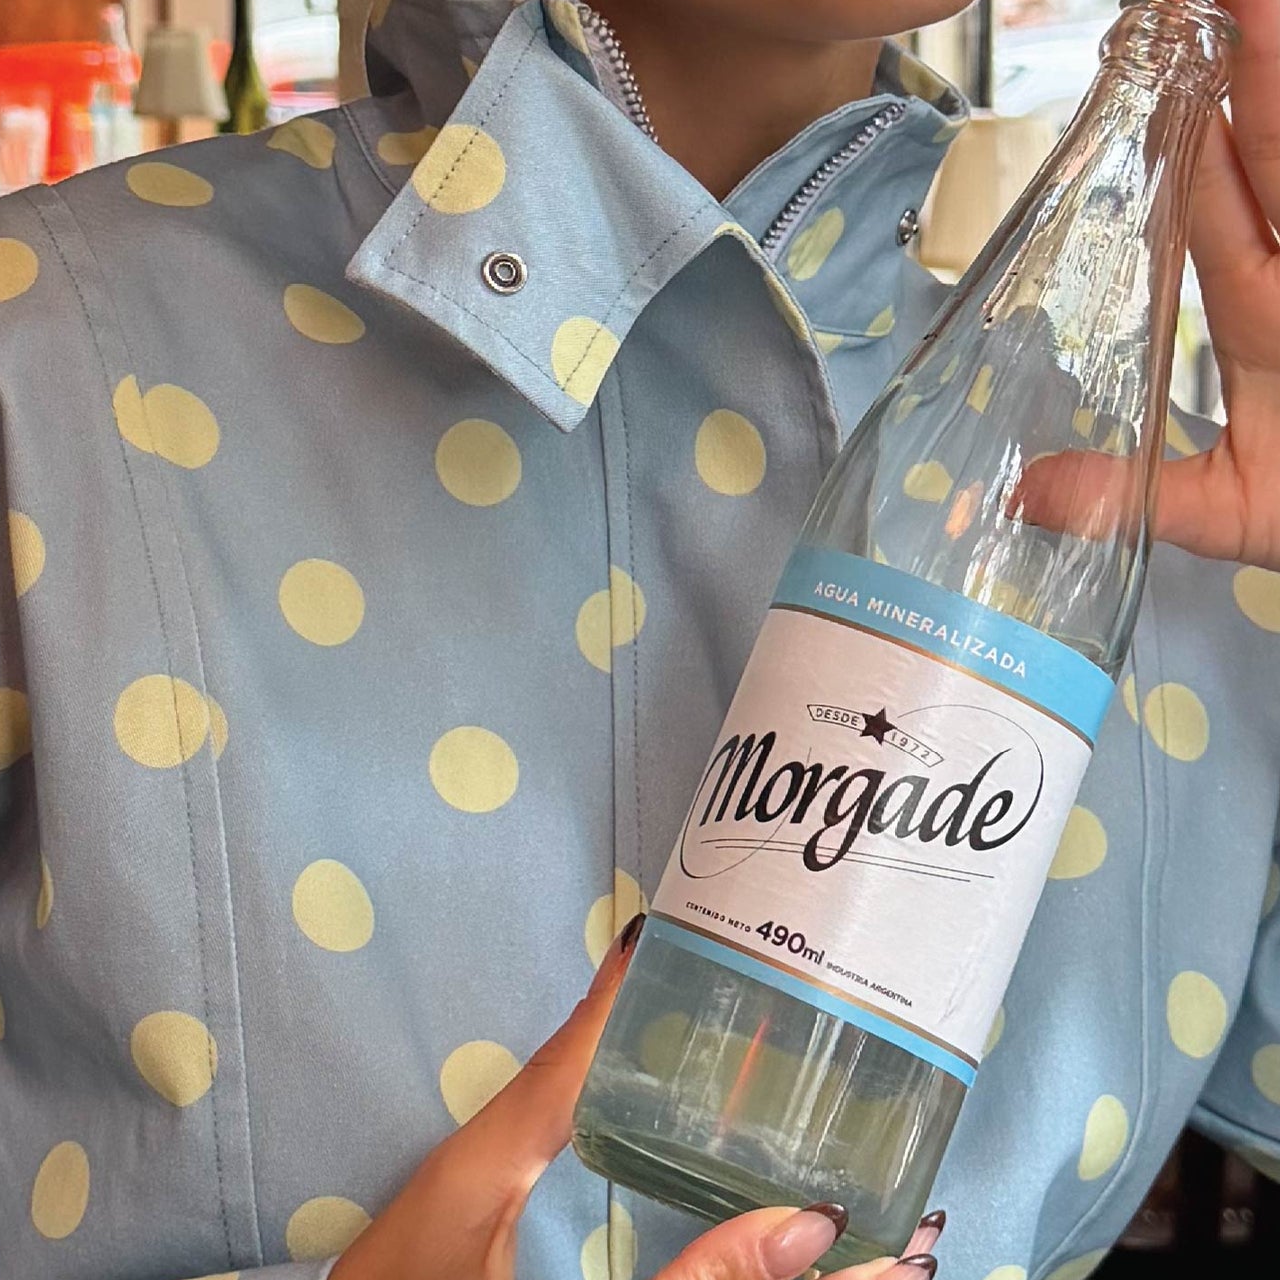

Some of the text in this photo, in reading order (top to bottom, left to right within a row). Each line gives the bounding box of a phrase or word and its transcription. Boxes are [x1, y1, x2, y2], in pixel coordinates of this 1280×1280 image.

[814, 581, 1026, 678] AGUA MINERALIZADA
[815, 706, 930, 759] DESDE 1972
[695, 729, 1024, 873] Morgade
